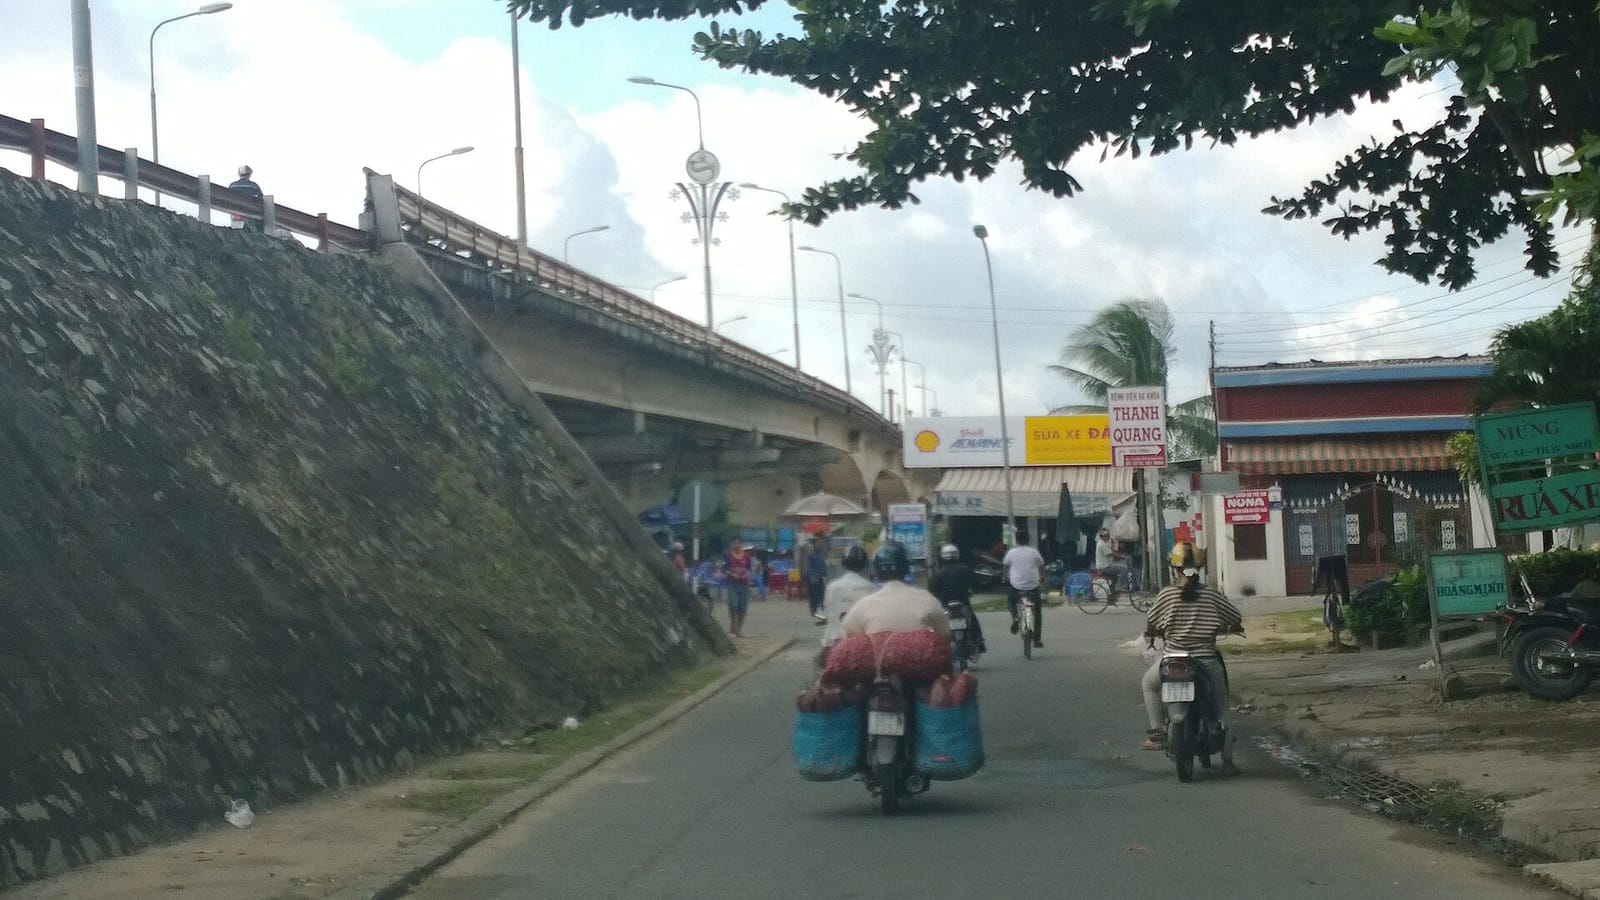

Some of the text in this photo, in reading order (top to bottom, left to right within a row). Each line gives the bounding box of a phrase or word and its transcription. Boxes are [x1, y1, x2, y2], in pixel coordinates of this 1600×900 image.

[1113, 406, 1160, 420] THANH
[960, 429, 985, 438] Shell
[1066, 430, 1081, 440] XE
[1113, 427, 1162, 444] QUANG
